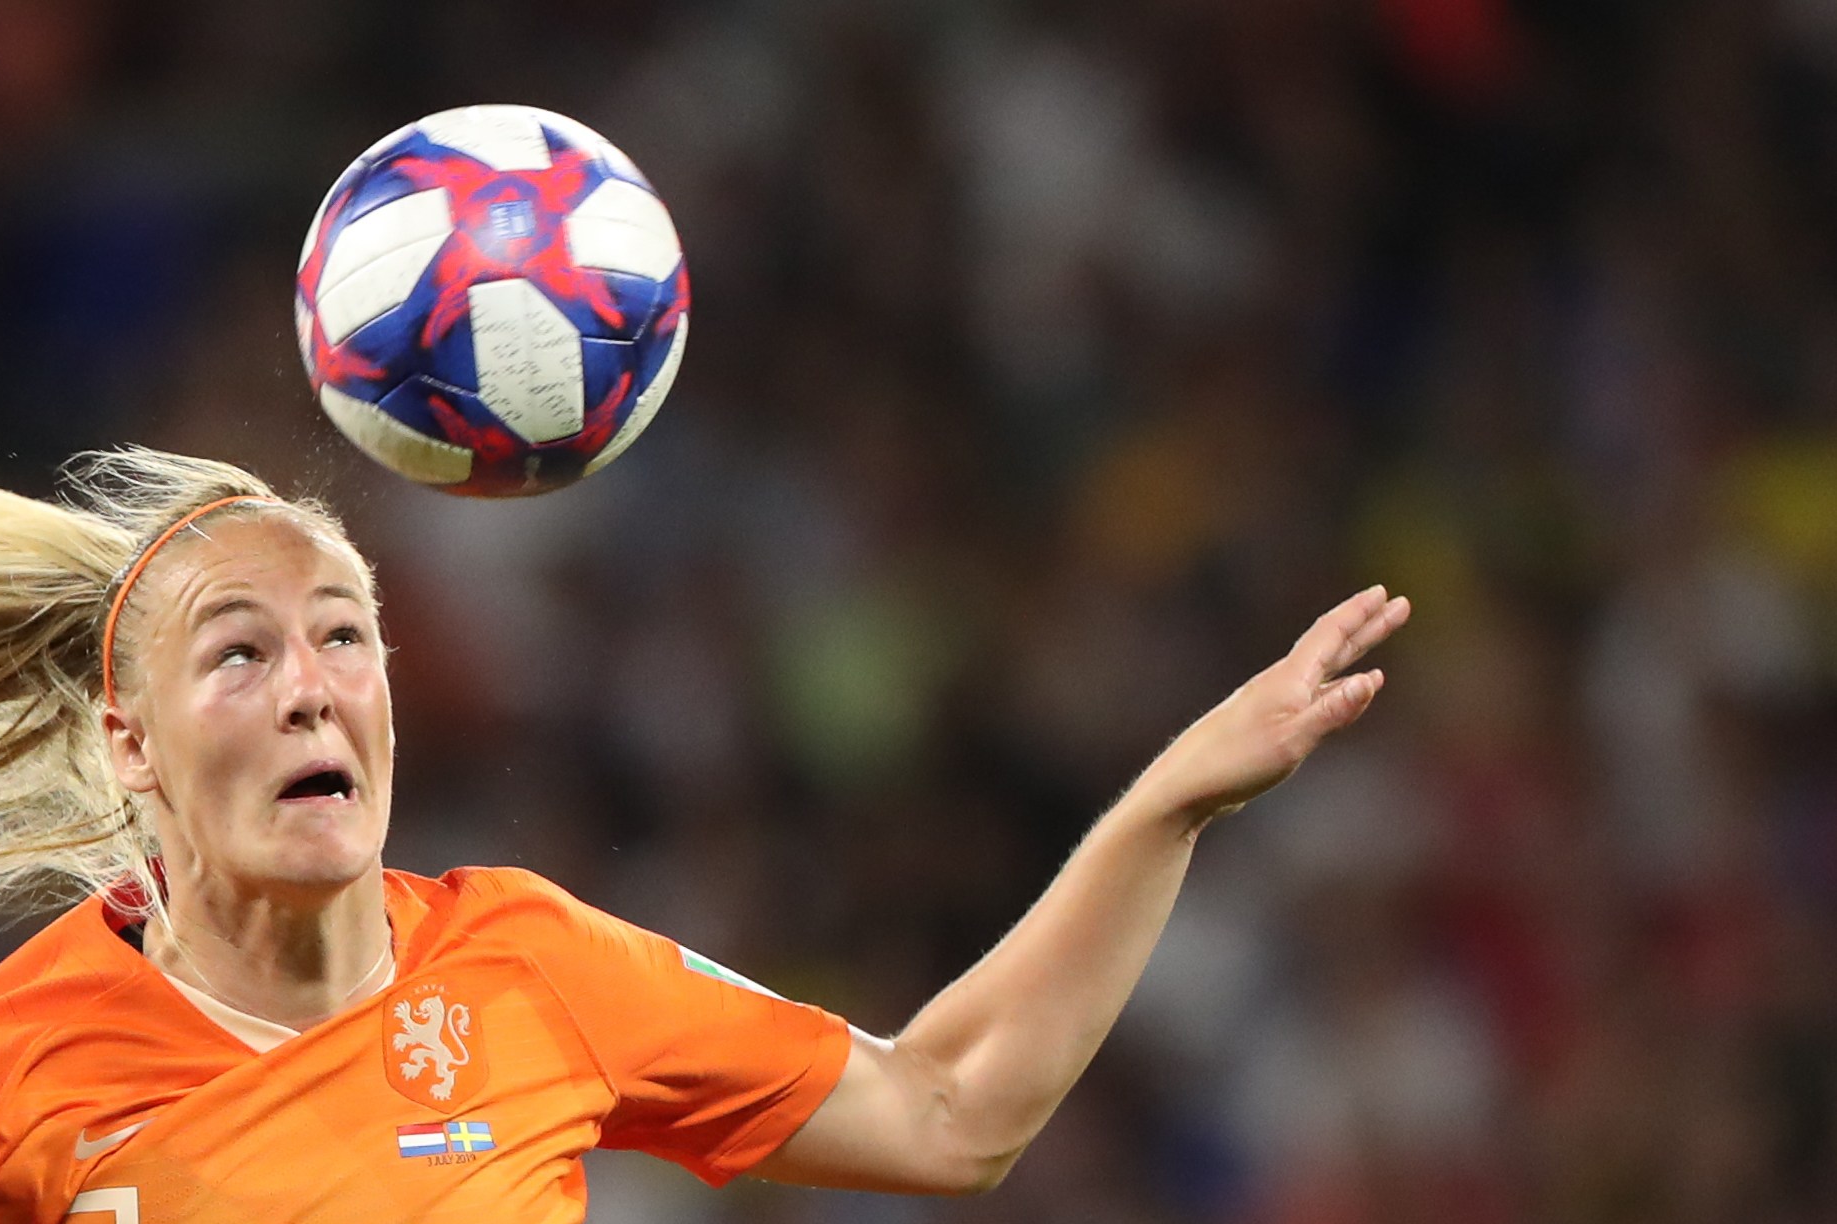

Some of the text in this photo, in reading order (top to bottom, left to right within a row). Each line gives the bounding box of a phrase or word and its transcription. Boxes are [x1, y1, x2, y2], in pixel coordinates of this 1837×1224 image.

[426, 1153, 477, 1167] 3 JULY 2019
